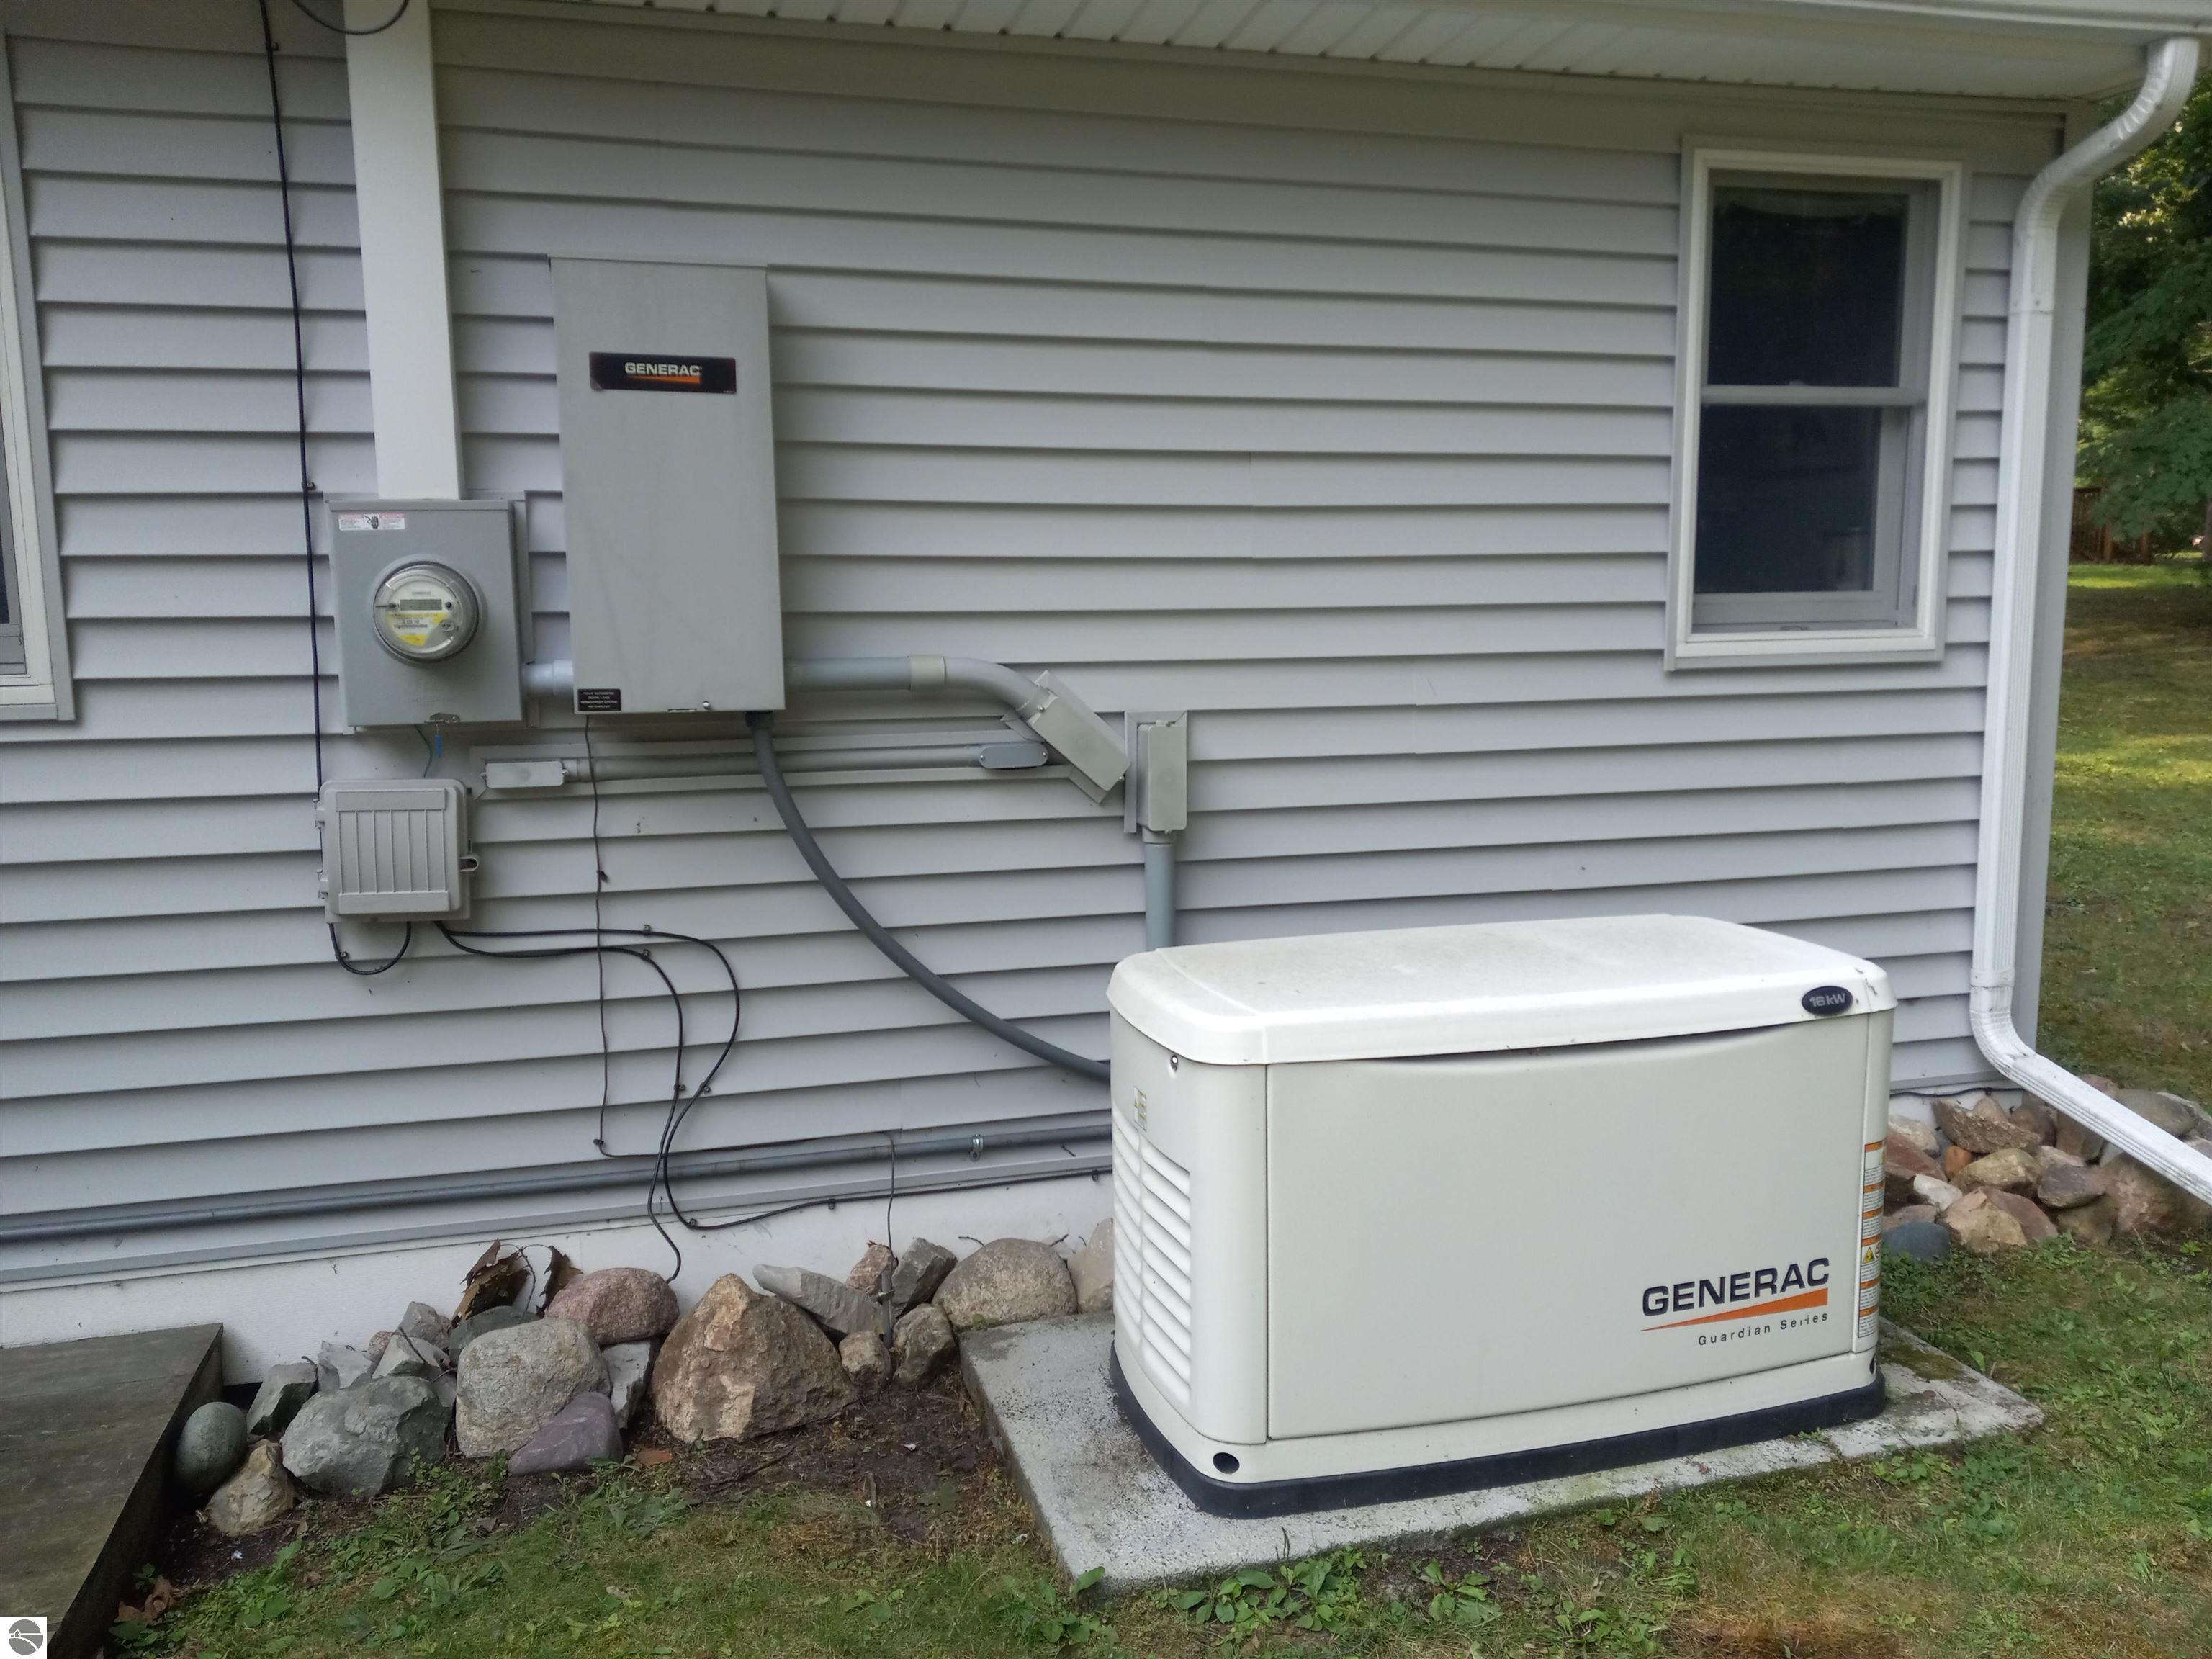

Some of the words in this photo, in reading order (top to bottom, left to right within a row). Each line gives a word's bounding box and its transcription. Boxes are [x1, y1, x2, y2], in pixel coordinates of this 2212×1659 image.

[625, 362, 700, 376] GENERAC
[1642, 1257, 1830, 1317] GENERAC
[1698, 1325, 1771, 1346] Guardian
[1780, 1313, 1827, 1330] Series
